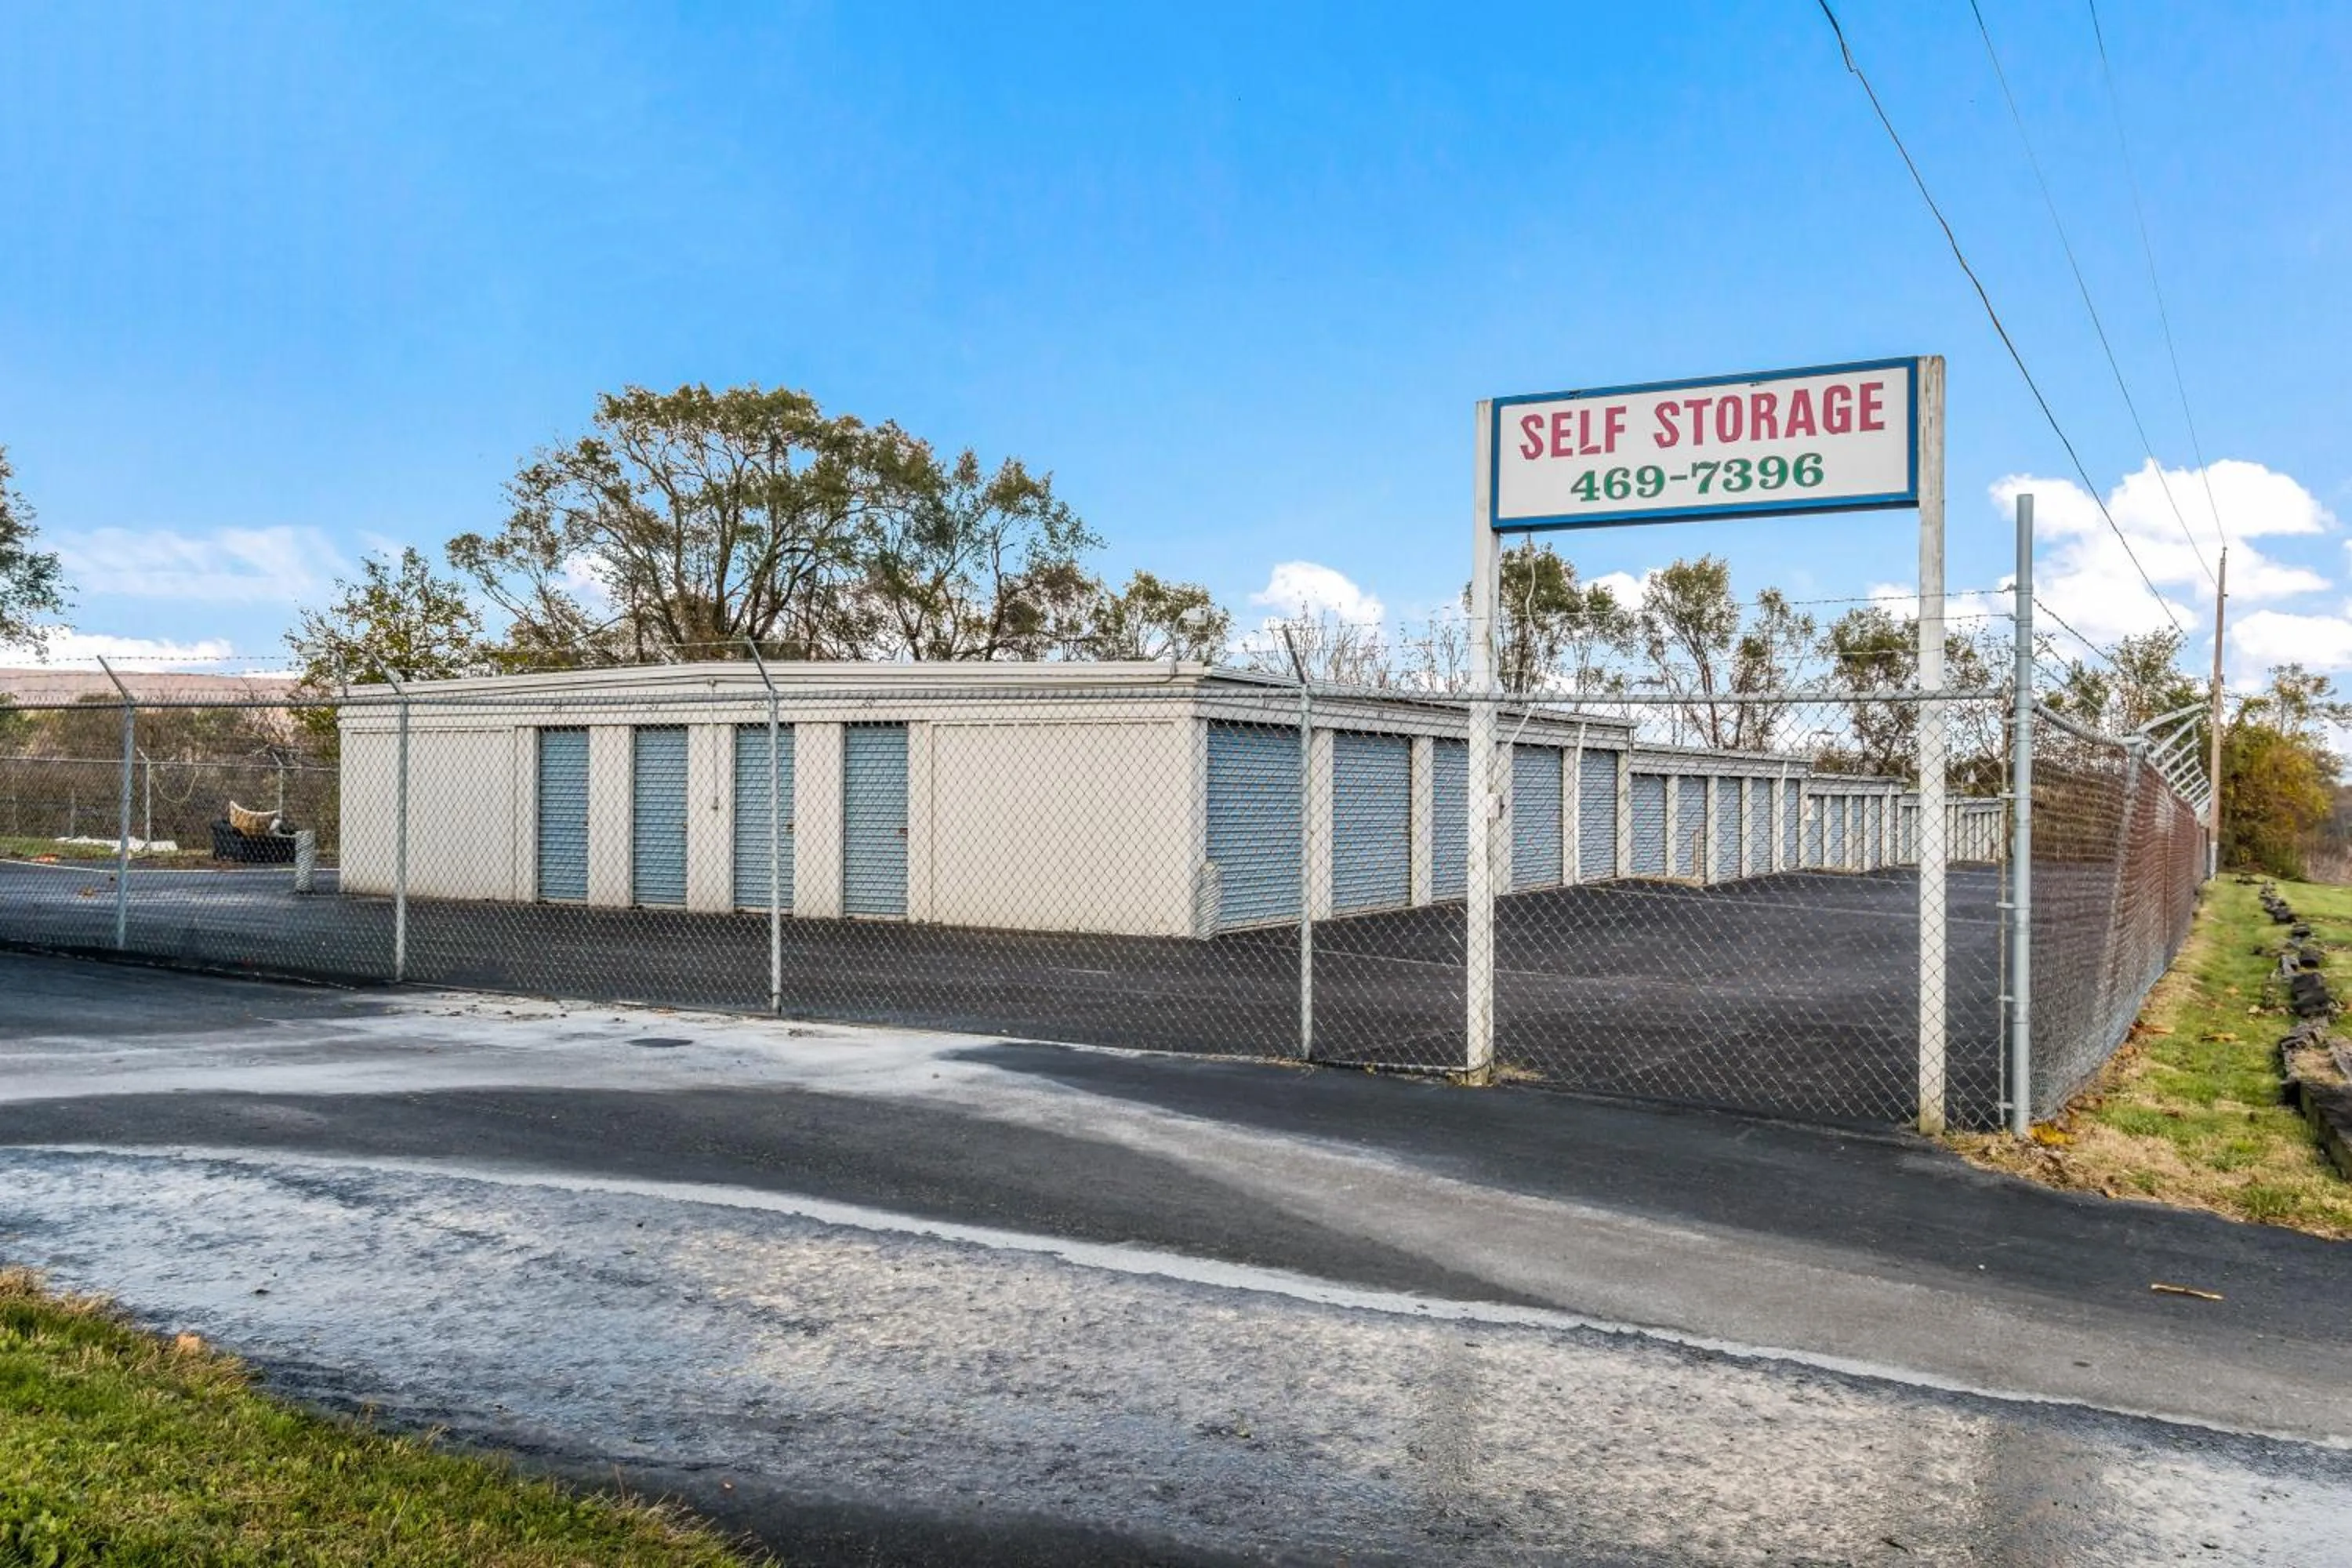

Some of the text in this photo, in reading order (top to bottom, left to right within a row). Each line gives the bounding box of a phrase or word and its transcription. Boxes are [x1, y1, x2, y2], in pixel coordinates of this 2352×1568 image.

[1519, 381, 1886, 460] SELF STORAGE
[1570, 452, 1825, 503] 469-7396
